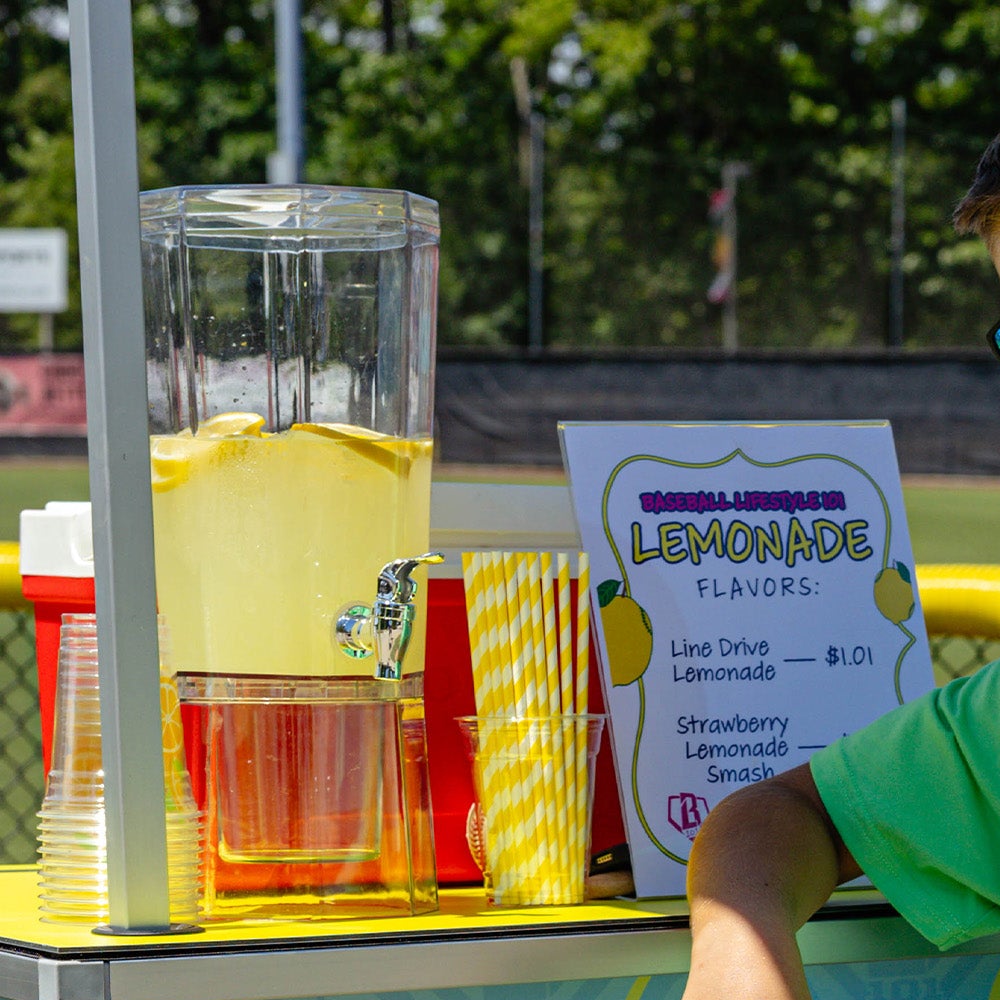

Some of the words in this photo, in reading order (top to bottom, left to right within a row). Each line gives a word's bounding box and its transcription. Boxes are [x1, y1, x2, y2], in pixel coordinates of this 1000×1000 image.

[639, 490, 732, 514] BASEBALL
[733, 490, 822, 514] LIFESTYLE
[821, 491, 846, 511] 101
[631, 516, 873, 567] LEMONADE
[696, 577, 820, 600] FLAVORS:
[671, 638, 713, 658] Line
[718, 637, 770, 657] Drive
[825, 645, 873, 668] $1.01
[673, 661, 776, 683] Lemonade
[676, 713, 788, 738] Strawberry
[685, 736, 789, 760] Lemonade
[706, 762, 775, 784] Smash
